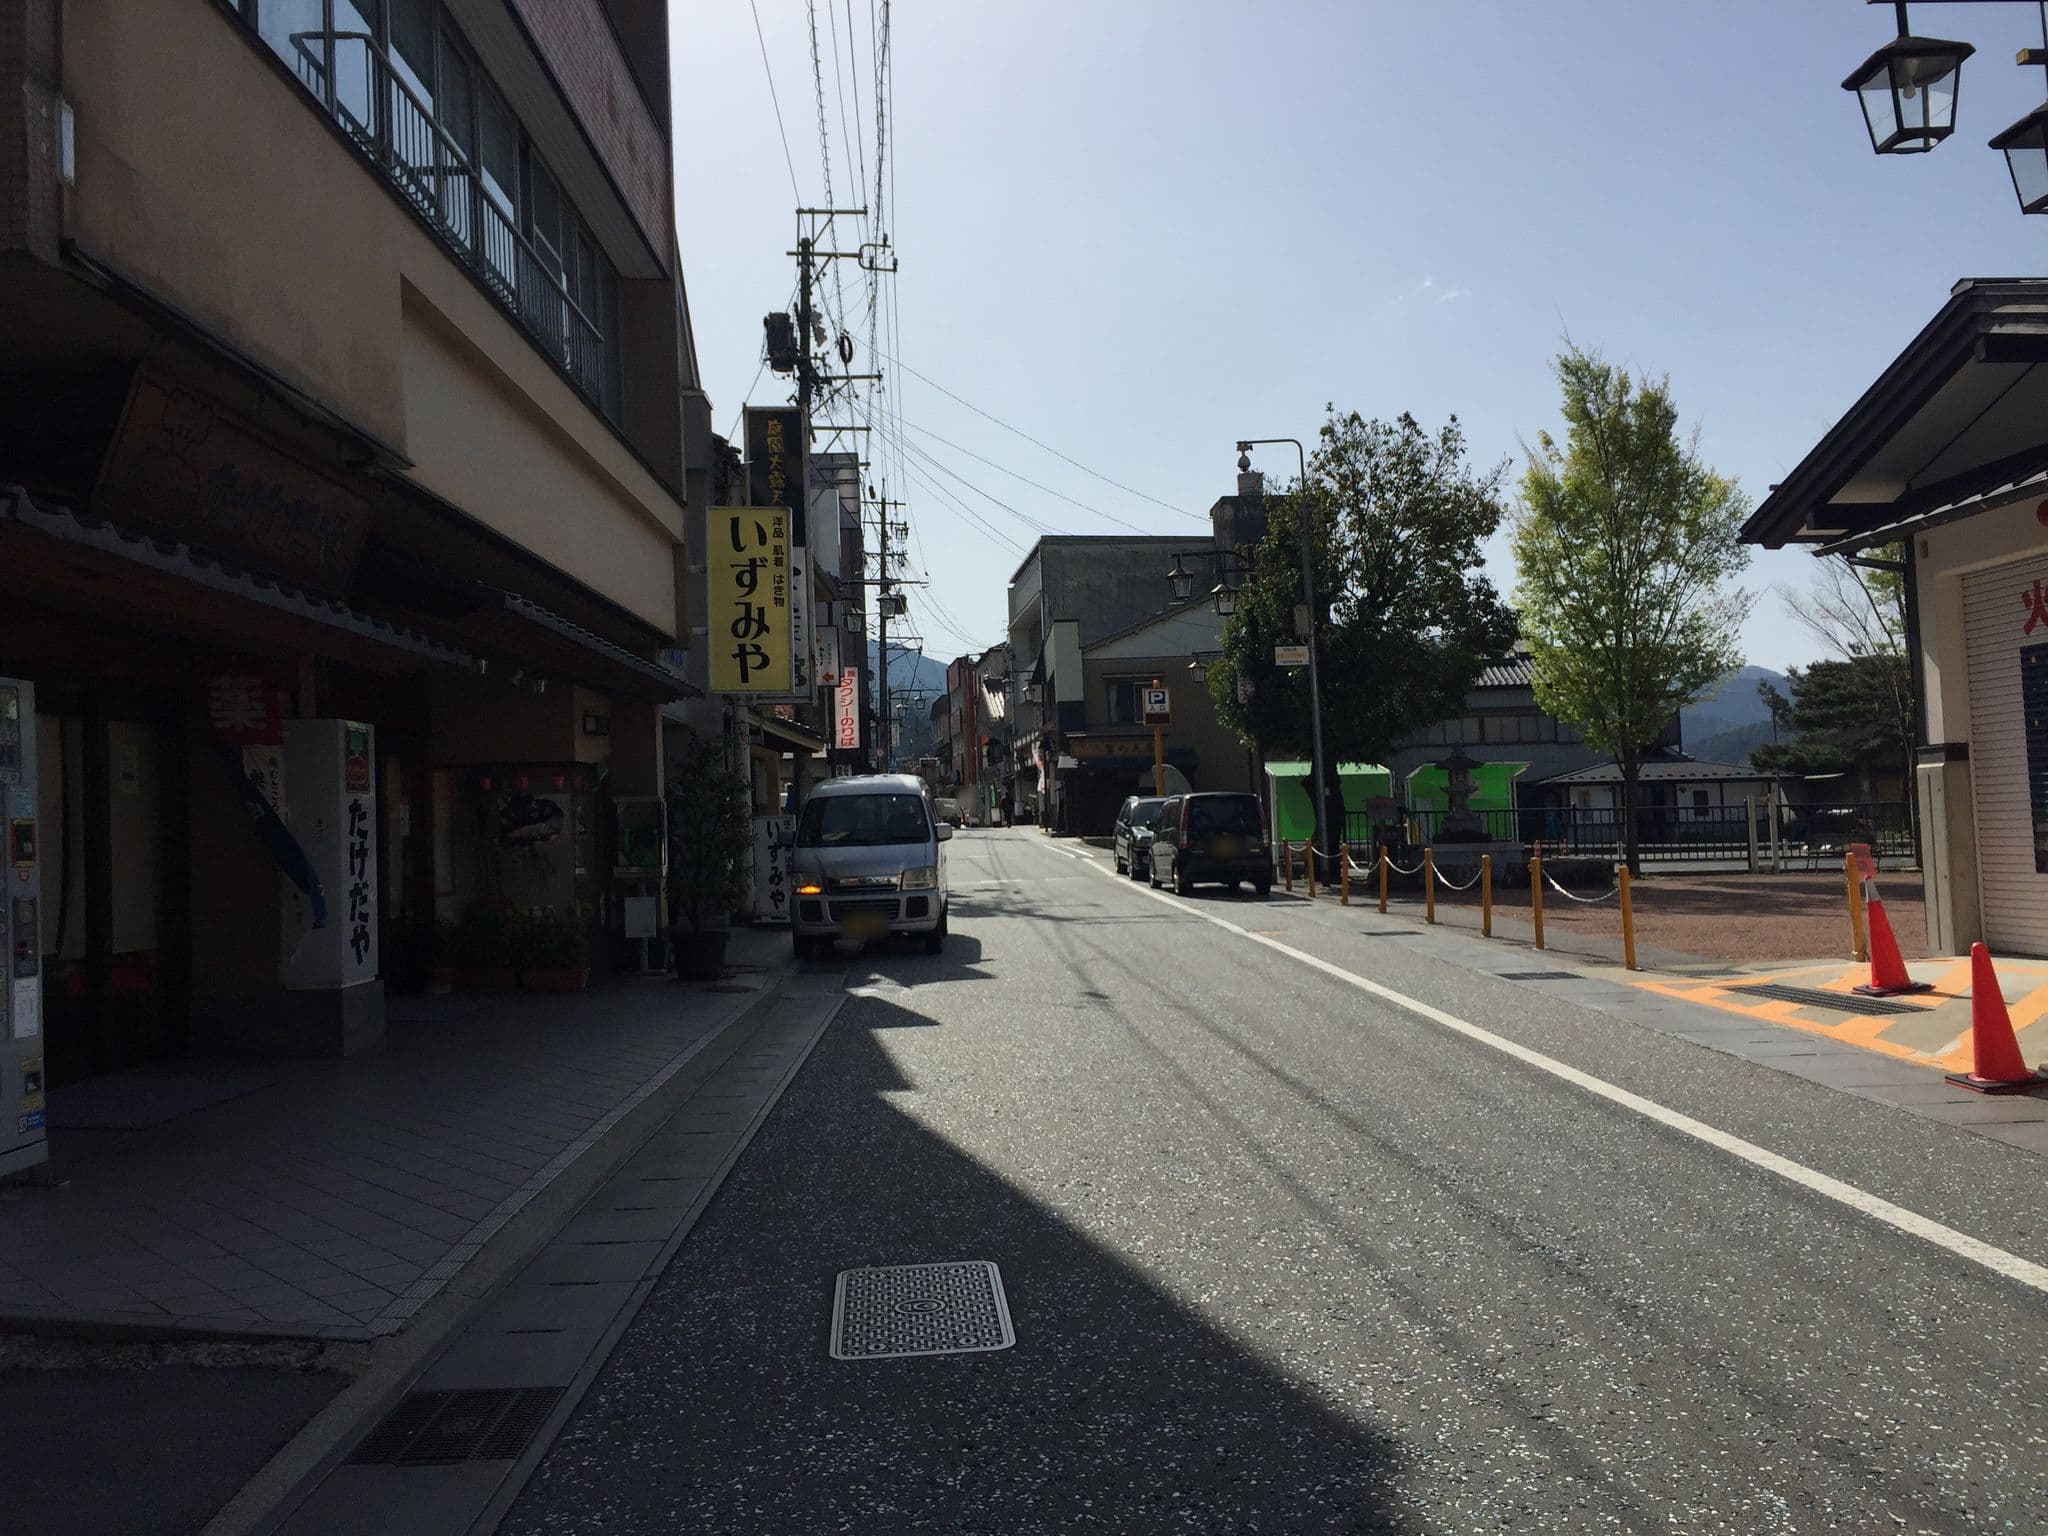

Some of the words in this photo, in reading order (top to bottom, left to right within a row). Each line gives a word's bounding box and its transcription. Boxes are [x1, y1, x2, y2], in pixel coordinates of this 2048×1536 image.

[772, 516, 784, 538] 洋品
[772, 545, 785, 567] 肌着
[730, 516, 771, 683] いずみや
[773, 573, 785, 608] はき物
[840, 678, 855, 747] タクシーのりば
[1150, 691, 1164, 704] P
[348, 798, 370, 966] たけだや
[767, 820, 786, 910] いずみや
